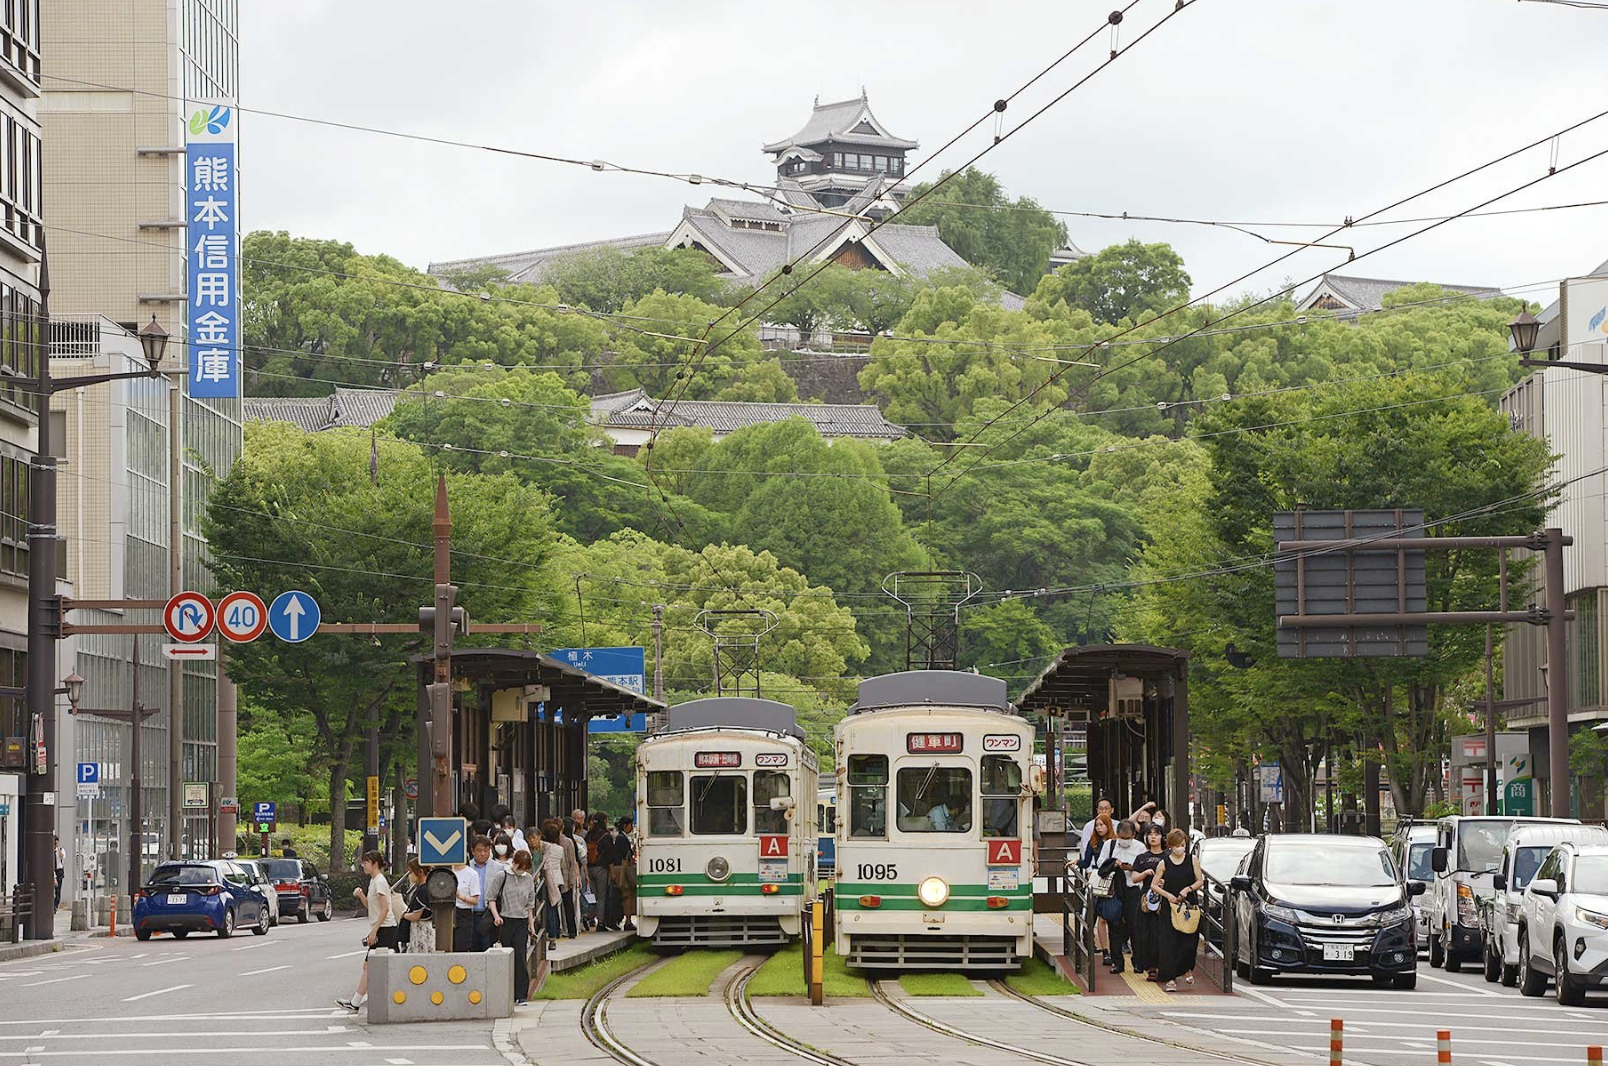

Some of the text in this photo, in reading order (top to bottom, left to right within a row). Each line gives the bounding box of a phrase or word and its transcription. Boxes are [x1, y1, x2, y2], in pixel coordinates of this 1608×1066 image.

[193, 155, 230, 384] 熊本信用金庫
[228, 606, 256, 628] 40
[911, 735, 957, 749] 健軍町
[986, 738, 1017, 748] ワンマン
[757, 756, 786, 764] ワンマン
[82, 765, 95, 782] P
[259, 803, 270, 813] P
[768, 838, 780, 854] A
[996, 842, 1013, 861] A
[649, 858, 682, 873] 1081
[857, 864, 898, 880] 1095
